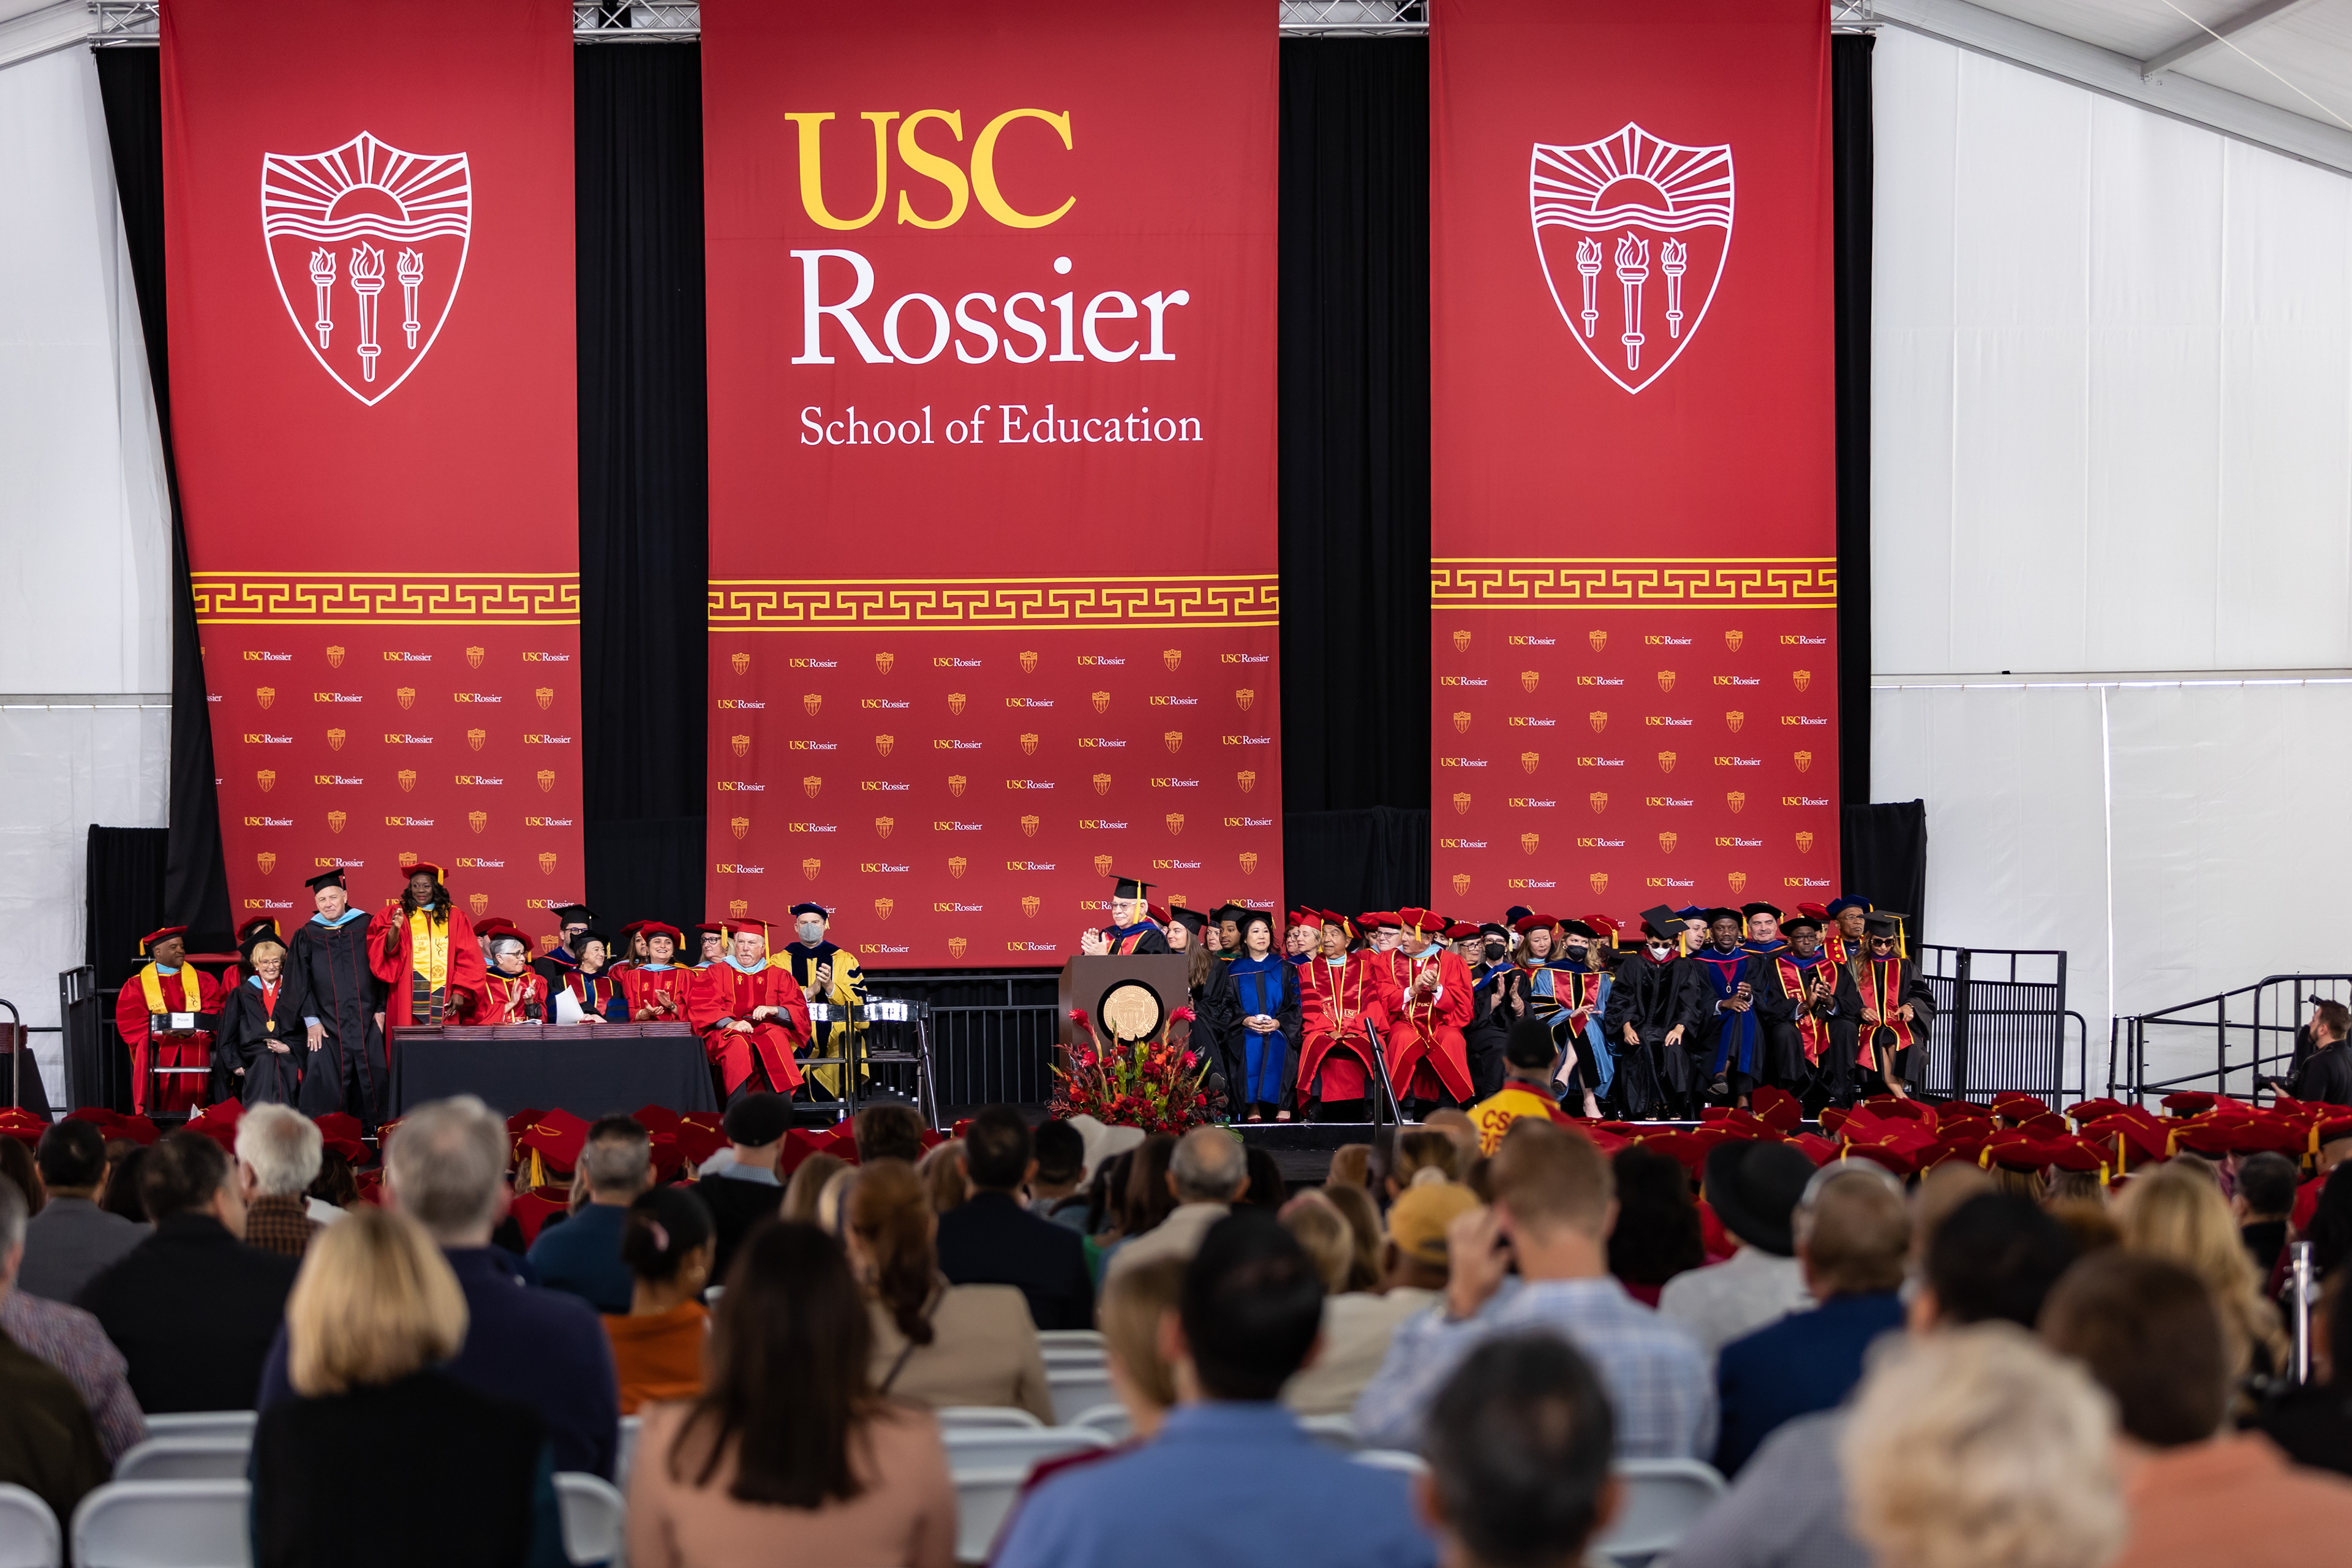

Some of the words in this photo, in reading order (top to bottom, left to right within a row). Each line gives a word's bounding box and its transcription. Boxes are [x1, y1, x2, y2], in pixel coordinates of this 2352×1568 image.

[784, 108, 1077, 231] USC
[790, 249, 1190, 364] Rossier
[801, 405, 935, 446] School
[945, 404, 991, 444] of
[998, 404, 1204, 443] Education
